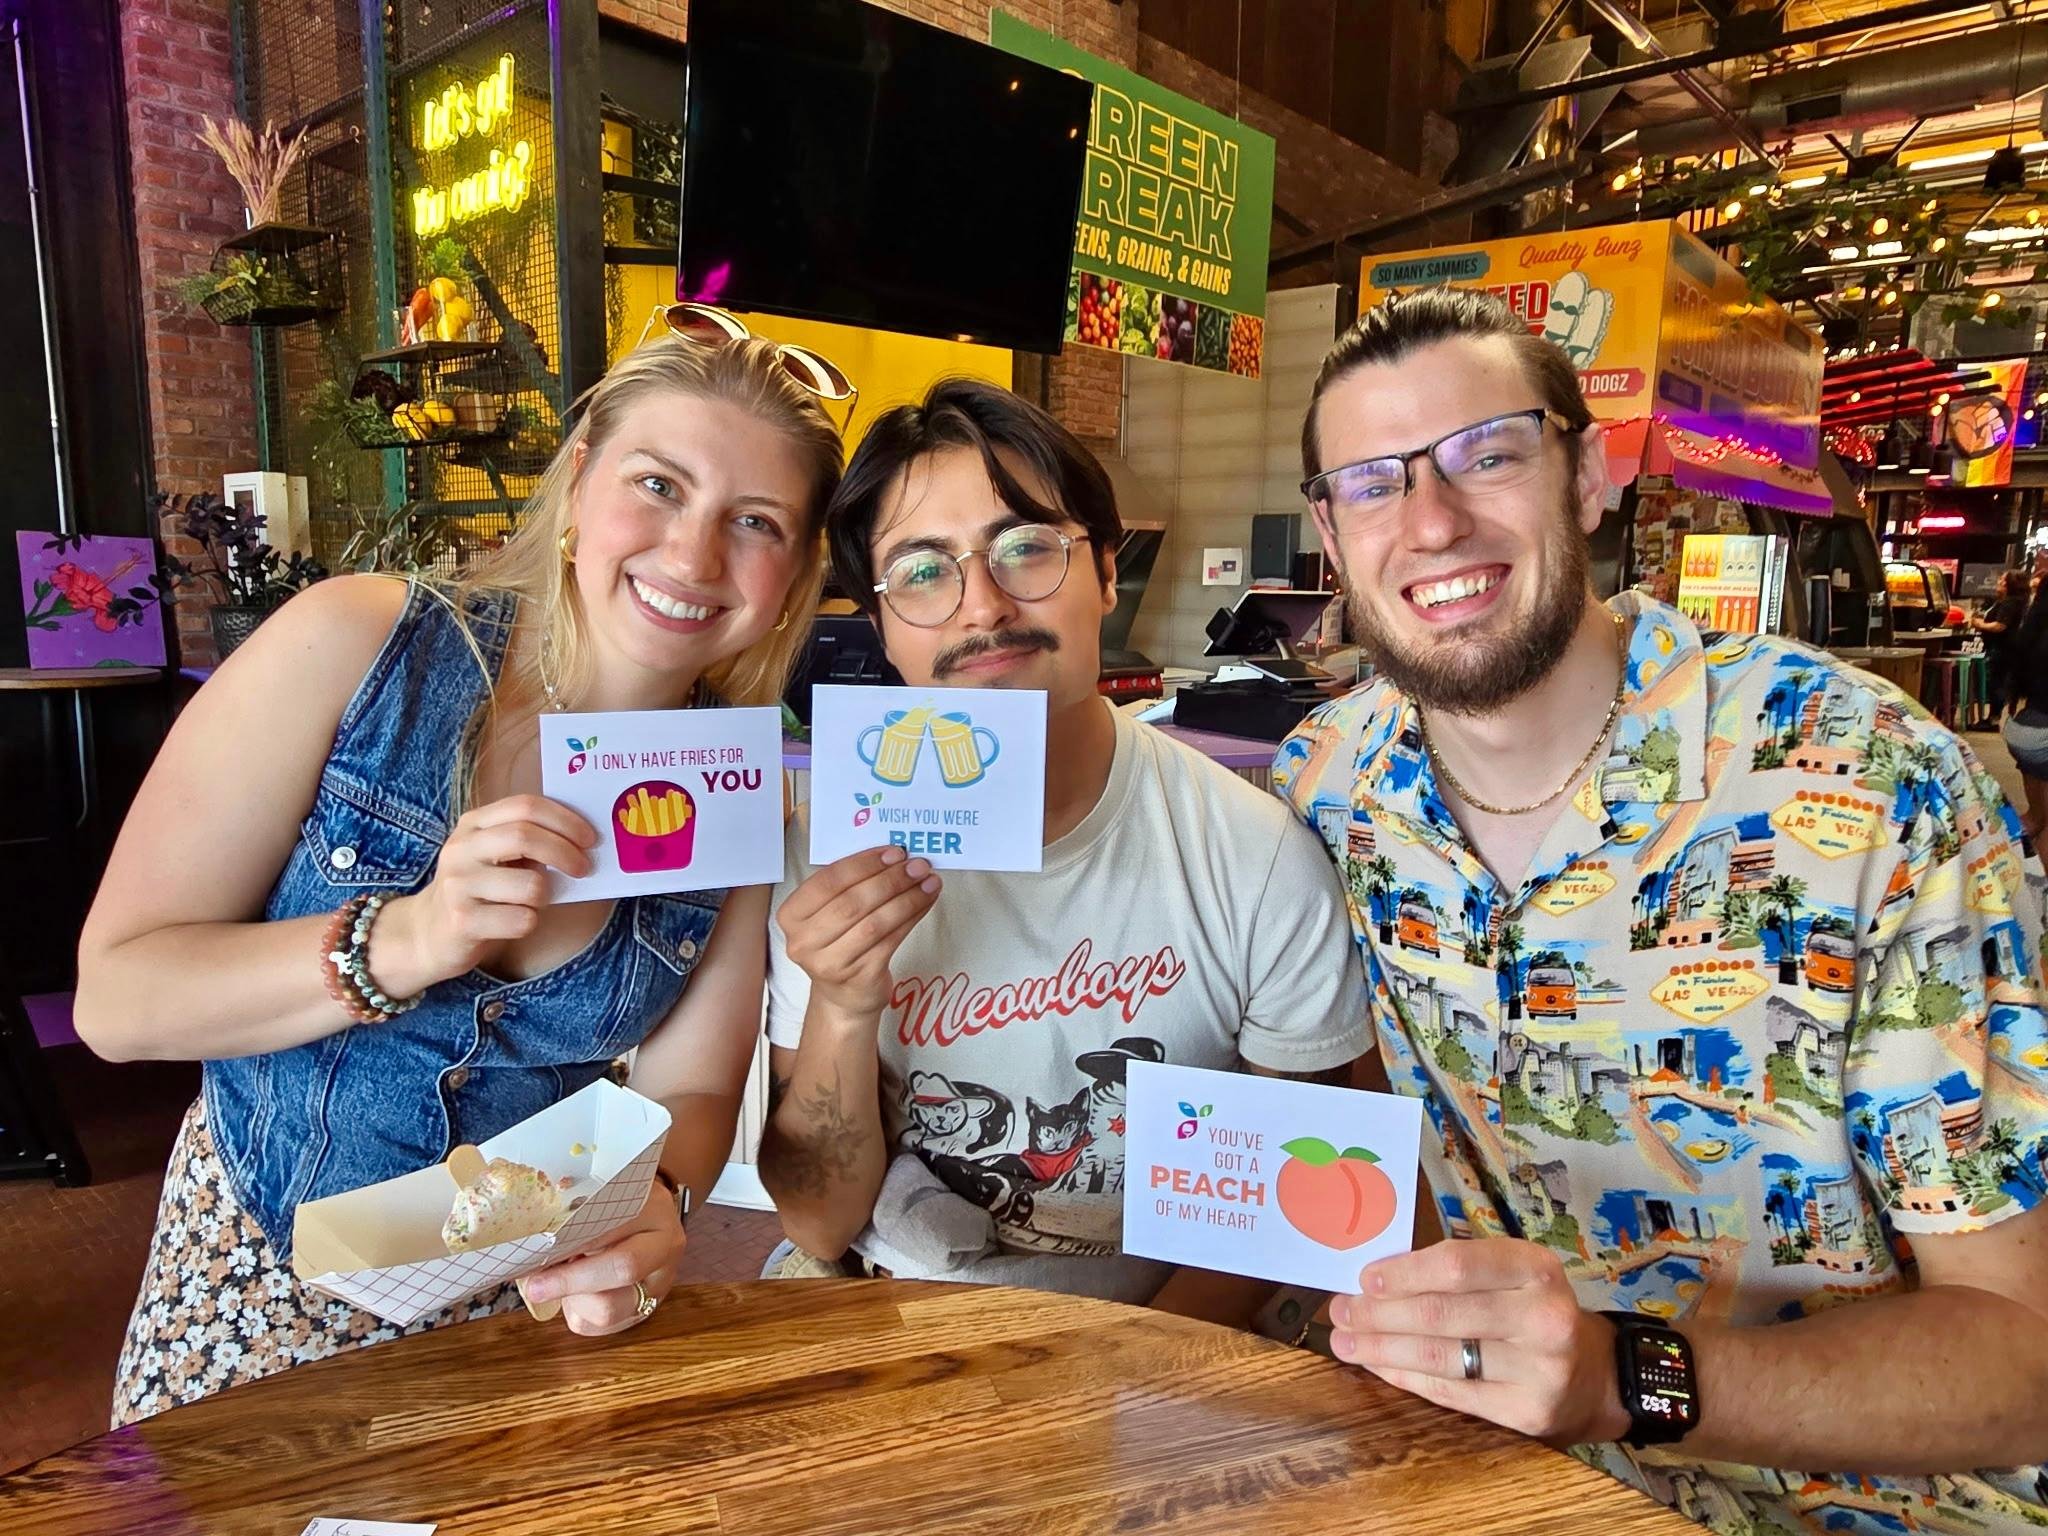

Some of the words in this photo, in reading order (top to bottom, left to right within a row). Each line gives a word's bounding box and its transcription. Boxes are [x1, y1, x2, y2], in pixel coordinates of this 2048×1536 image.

[1086, 83, 1239, 202] REEN
[1074, 222, 1112, 266] ENS,
[1117, 235, 1174, 283] GRAINS,
[1177, 254, 1190, 285] &
[1191, 259, 1232, 295] GAINS
[1519, 241, 1588, 270] Quality
[1593, 236, 1643, 261] Bunz
[1378, 267, 1392, 283] SO
[1394, 264, 1425, 281] MANY
[1427, 258, 1479, 278] SAMMIES
[1590, 373, 1629, 394] DOGZ
[593, 754, 598, 770] I
[602, 753, 636, 770] ONLY
[641, 751, 676, 768] HAVE
[681, 749, 716, 766] FRIES
[720, 748, 744, 764] FOR
[701, 769, 762, 793] YOU
[878, 807, 910, 824] WISH
[914, 808, 940, 825] YOU
[943, 810, 980, 826] WERE
[1783, 814, 1817, 829] LAS
[1834, 822, 1874, 842] VEGA
[889, 830, 963, 854] BEER
[1564, 884, 1605, 894] VEGAS
[889, 938, 1186, 1047] Meowboys
[1662, 989, 1691, 1003] LAS
[1706, 985, 1756, 998] VEGAS
[1208, 1127, 1264, 1151] YOU'VE
[1214, 1151, 1242, 1172] GOT
[1249, 1159, 1260, 1174] A
[1150, 1165, 1265, 1206] PEACH
[1156, 1199, 1173, 1216] OF
[1179, 1204, 1203, 1222] MY
[1207, 1208, 1258, 1232] HEART
